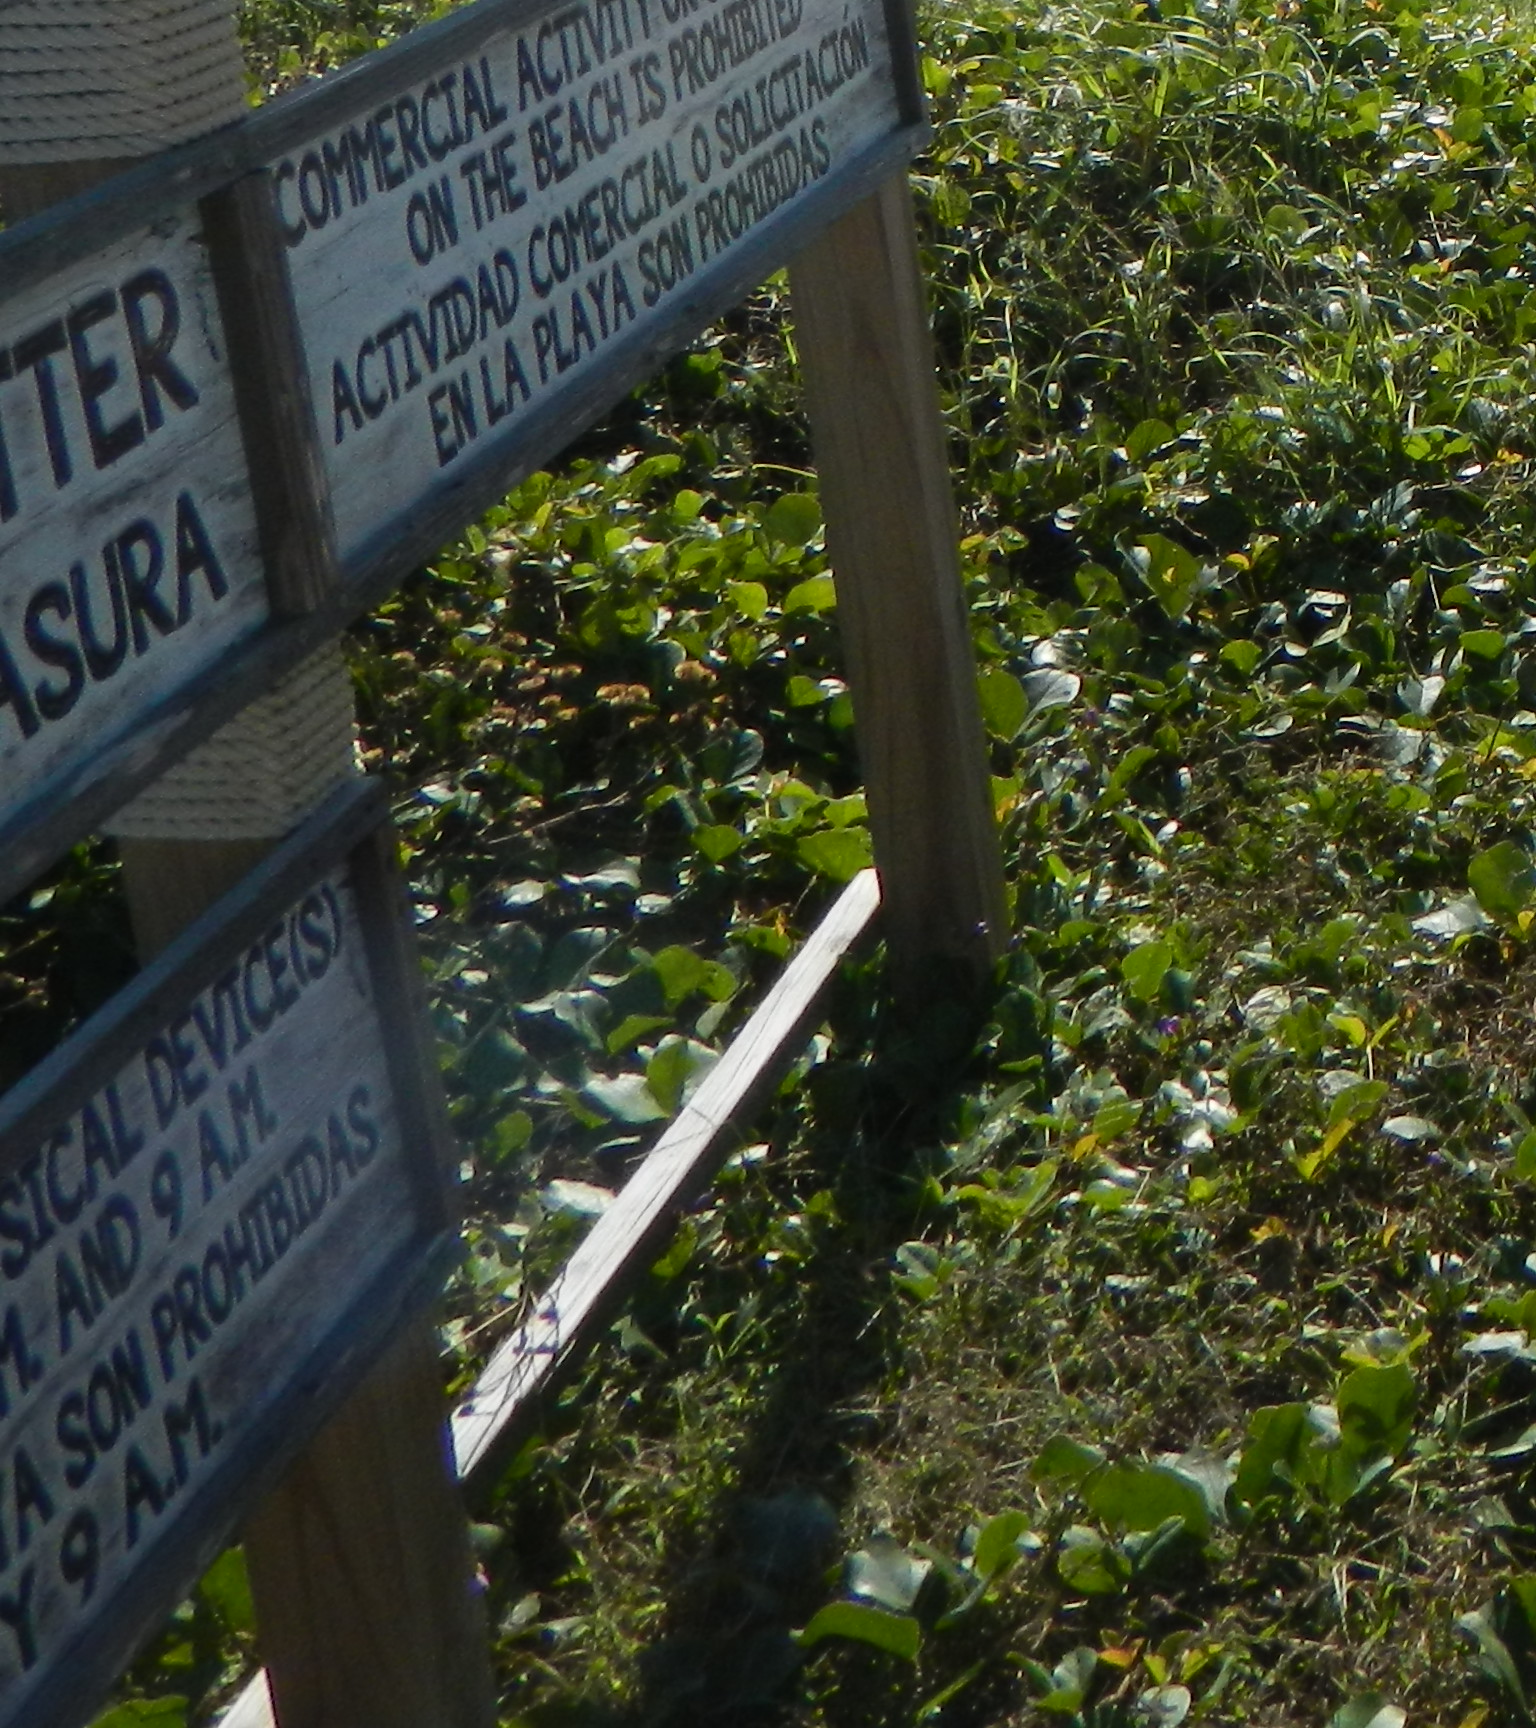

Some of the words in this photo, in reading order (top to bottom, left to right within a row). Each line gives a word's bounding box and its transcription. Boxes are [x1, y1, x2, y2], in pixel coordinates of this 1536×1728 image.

[271, 60, 509, 250] COMMERCIAL
[332, 247, 520, 445] ACTIVIDAD
[527, 160, 688, 299] COMERCIAL
[690, 128, 713, 180] O
[715, 5, 870, 149] SOLICITACIÓN
[405, 175, 459, 267] ON
[460, 138, 526, 232] THE
[529, 82, 630, 190] BEACH
[635, 57, 667, 127] IS
[429, 385, 478, 468] EN
[484, 339, 532, 427] LA
[533, 271, 637, 390] PLAYA
[638, 228, 695, 312] SON
[696, 121, 830, 264] PROHIBIDAS
[144, 875, 346, 1124] DEVICE(S)
[55, 1193, 143, 1357] AND
[150, 1149, 184, 1241] 9
[200, 1065, 276, 1199] A.M.
[56, 1328, 153, 1489] SON
[150, 1083, 381, 1388] PROHIBIDAS
[60, 1507, 99, 1608] 9
[125, 1375, 226, 1551] A.M.
